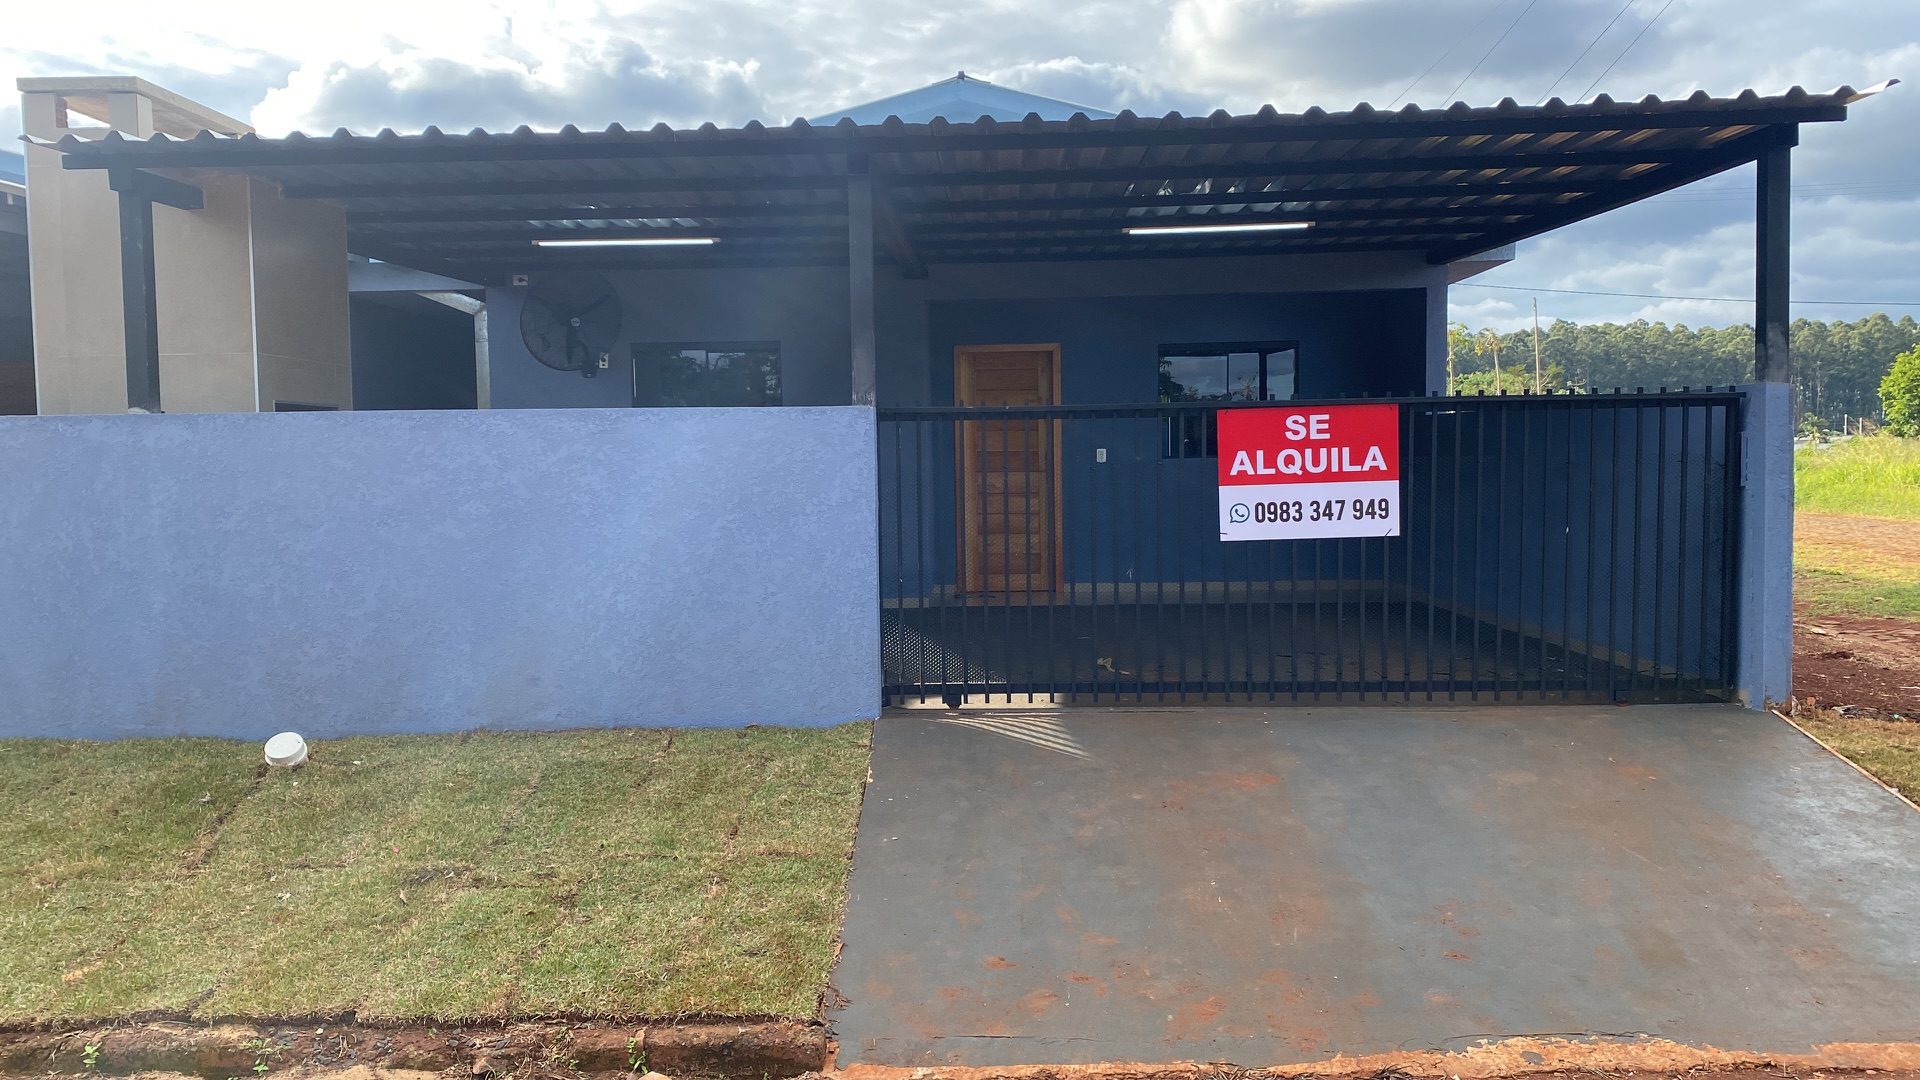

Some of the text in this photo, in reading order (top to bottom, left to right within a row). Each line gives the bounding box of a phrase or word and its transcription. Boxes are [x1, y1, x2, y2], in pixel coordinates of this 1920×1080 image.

[1285, 413, 1330, 441] SE
[1229, 446, 1388, 476] ALQUILA
[1254, 498, 1389, 523] 0983 347 949
